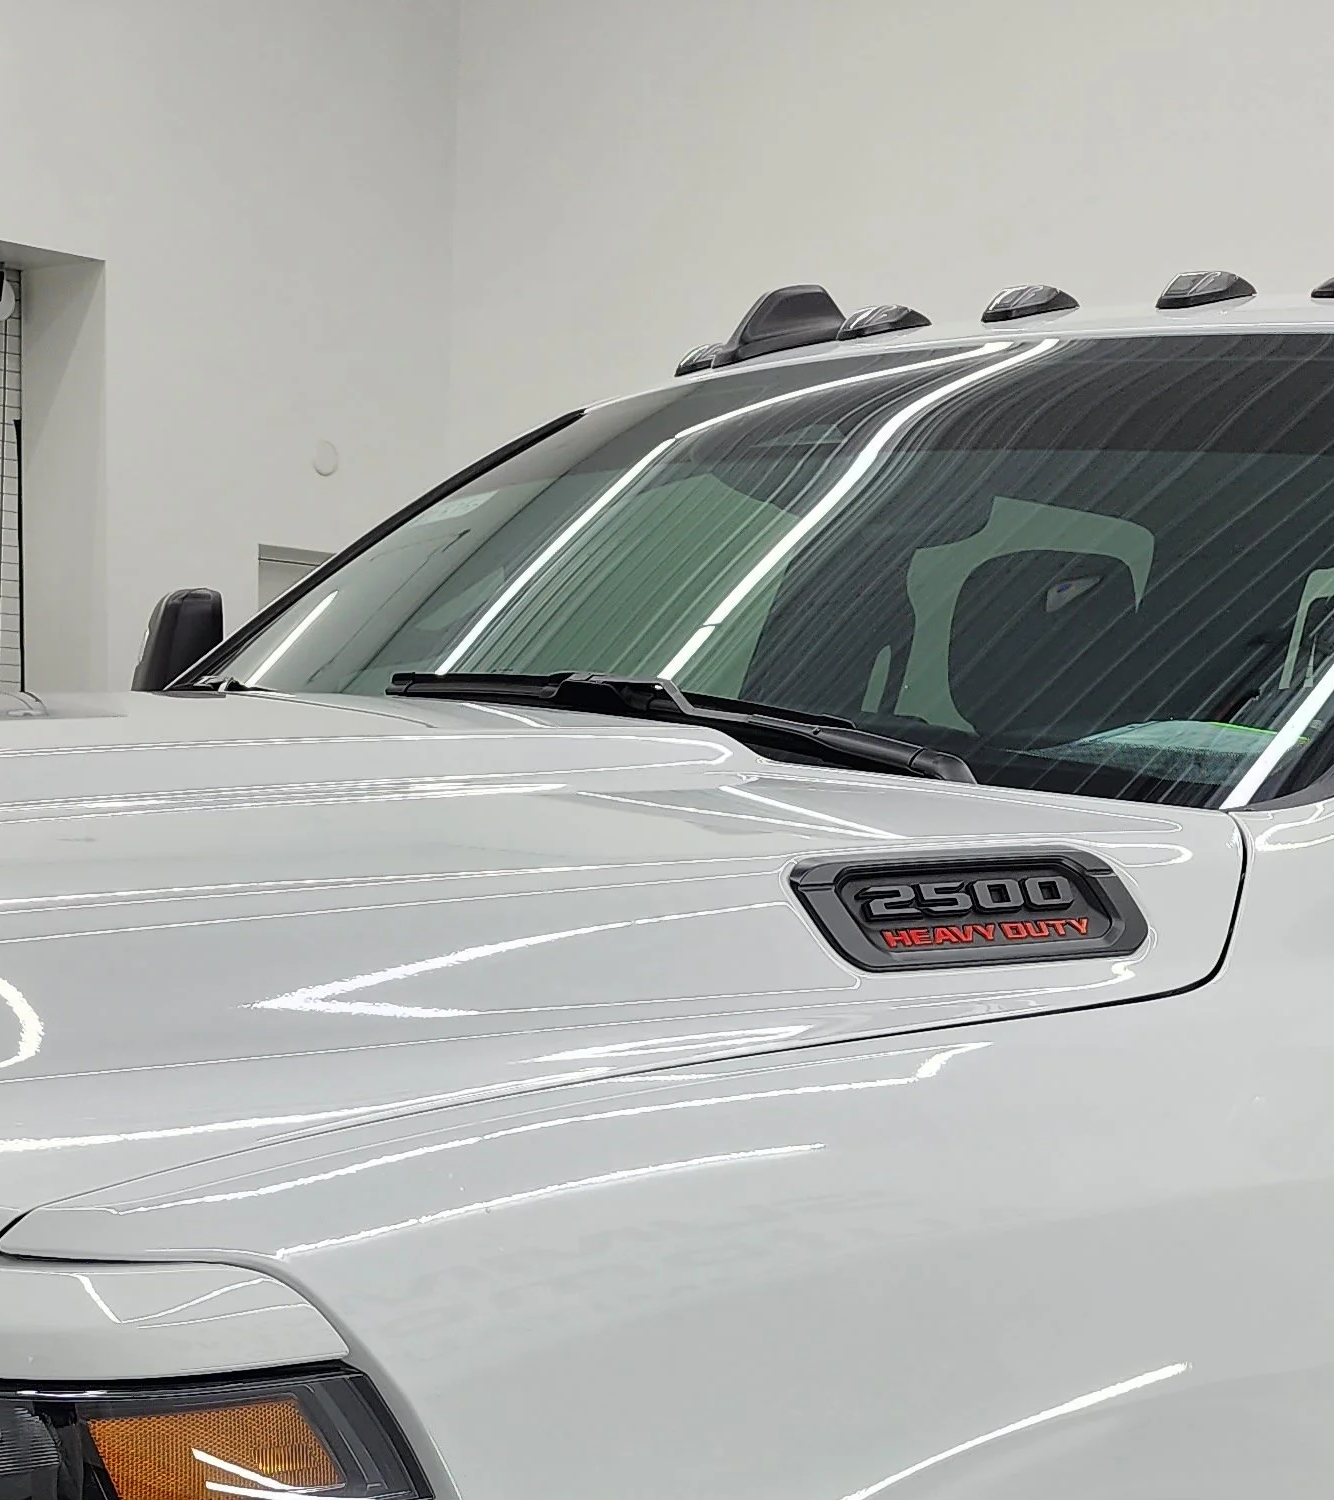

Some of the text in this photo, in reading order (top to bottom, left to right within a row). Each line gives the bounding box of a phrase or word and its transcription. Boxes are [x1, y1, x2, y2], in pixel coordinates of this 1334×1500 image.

[856, 876, 1074, 921] 2500
[879, 917, 1090, 948] HEAVY DUTY
